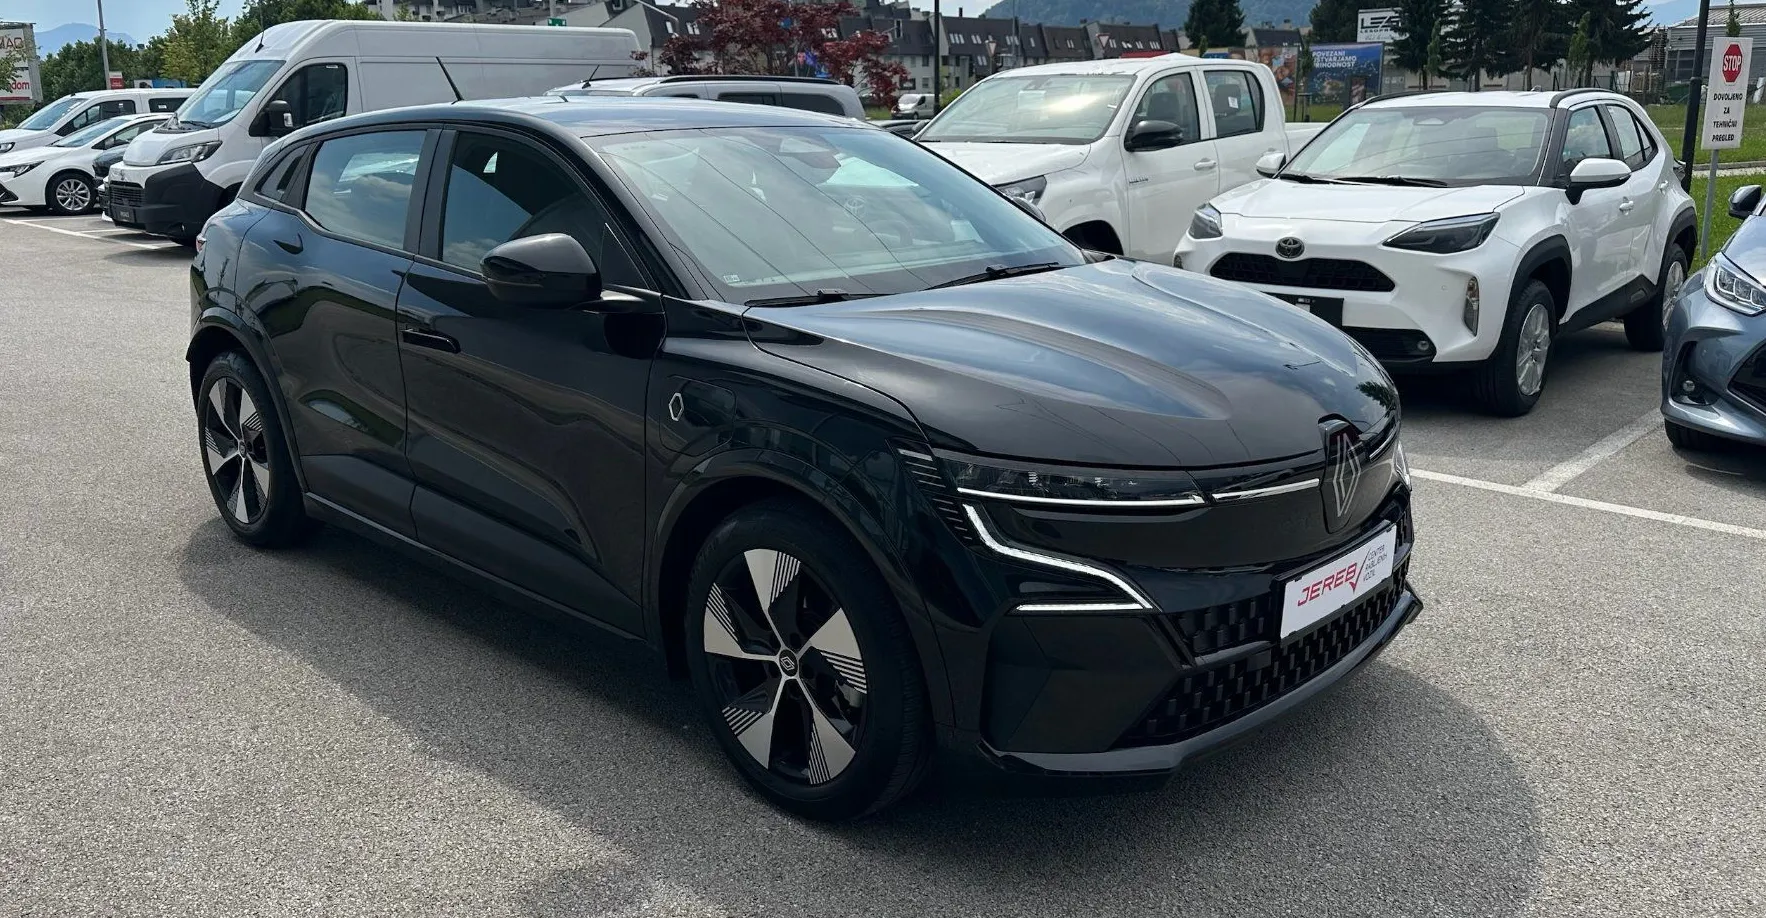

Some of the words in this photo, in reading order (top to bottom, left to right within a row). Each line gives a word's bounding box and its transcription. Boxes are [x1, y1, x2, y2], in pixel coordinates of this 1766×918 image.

[1723, 55, 1742, 72] STOP
[1713, 92, 1743, 101] DOVOLJENO
[1711, 133, 1735, 142] PREGLED
[1368, 544, 1385, 561] CENTER
[1297, 562, 1358, 607] JEREB
